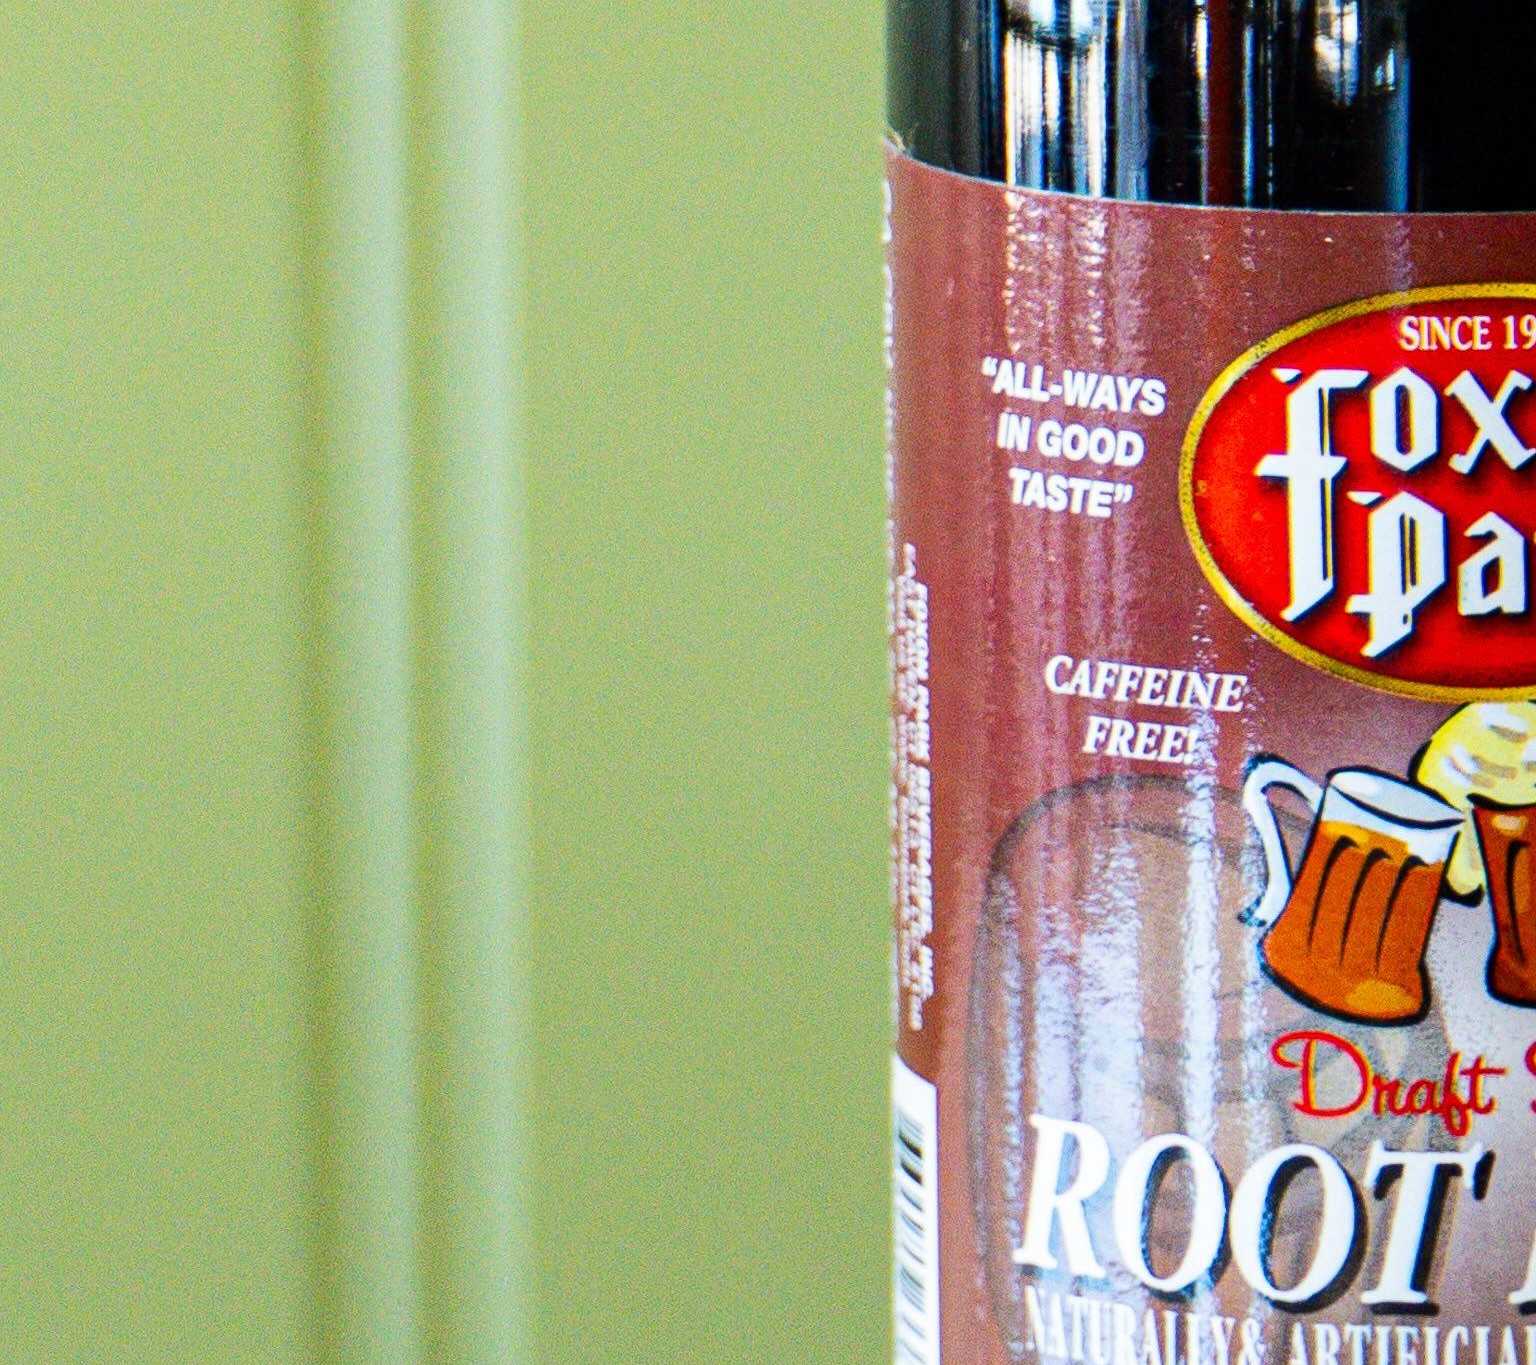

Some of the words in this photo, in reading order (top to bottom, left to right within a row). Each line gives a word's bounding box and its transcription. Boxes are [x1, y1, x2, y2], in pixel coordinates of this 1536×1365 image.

[1398, 315, 1493, 351] SINCE
[996, 412, 1032, 452] IN
[1036, 419, 1146, 467] GOOD
[1044, 654, 1249, 713] CAFFEINE
[1270, 1030, 1509, 1137] Draft
[1013, 1113, 1487, 1307] ROOT
